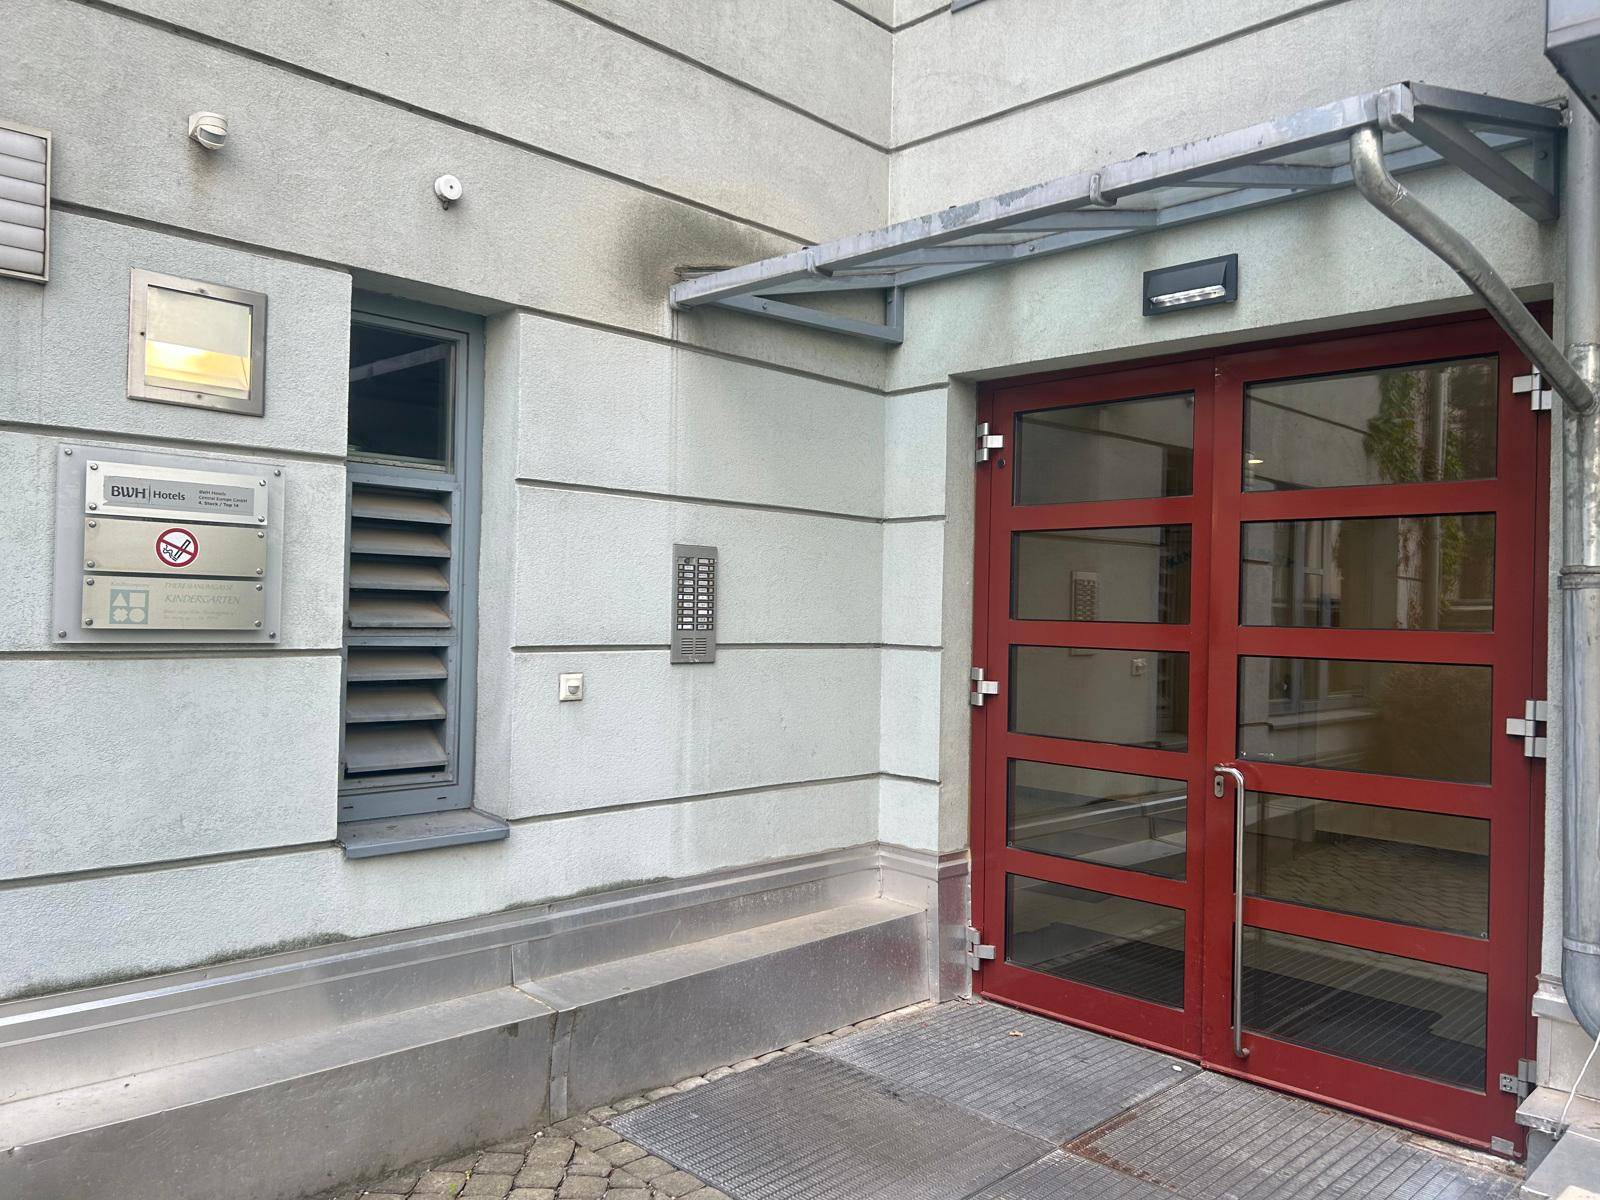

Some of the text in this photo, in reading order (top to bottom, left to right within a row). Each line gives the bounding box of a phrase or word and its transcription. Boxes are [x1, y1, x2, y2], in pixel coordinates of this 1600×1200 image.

[111, 485, 185, 501] BWH Hotels
[164, 594, 240, 605] KINDERGARTEN
